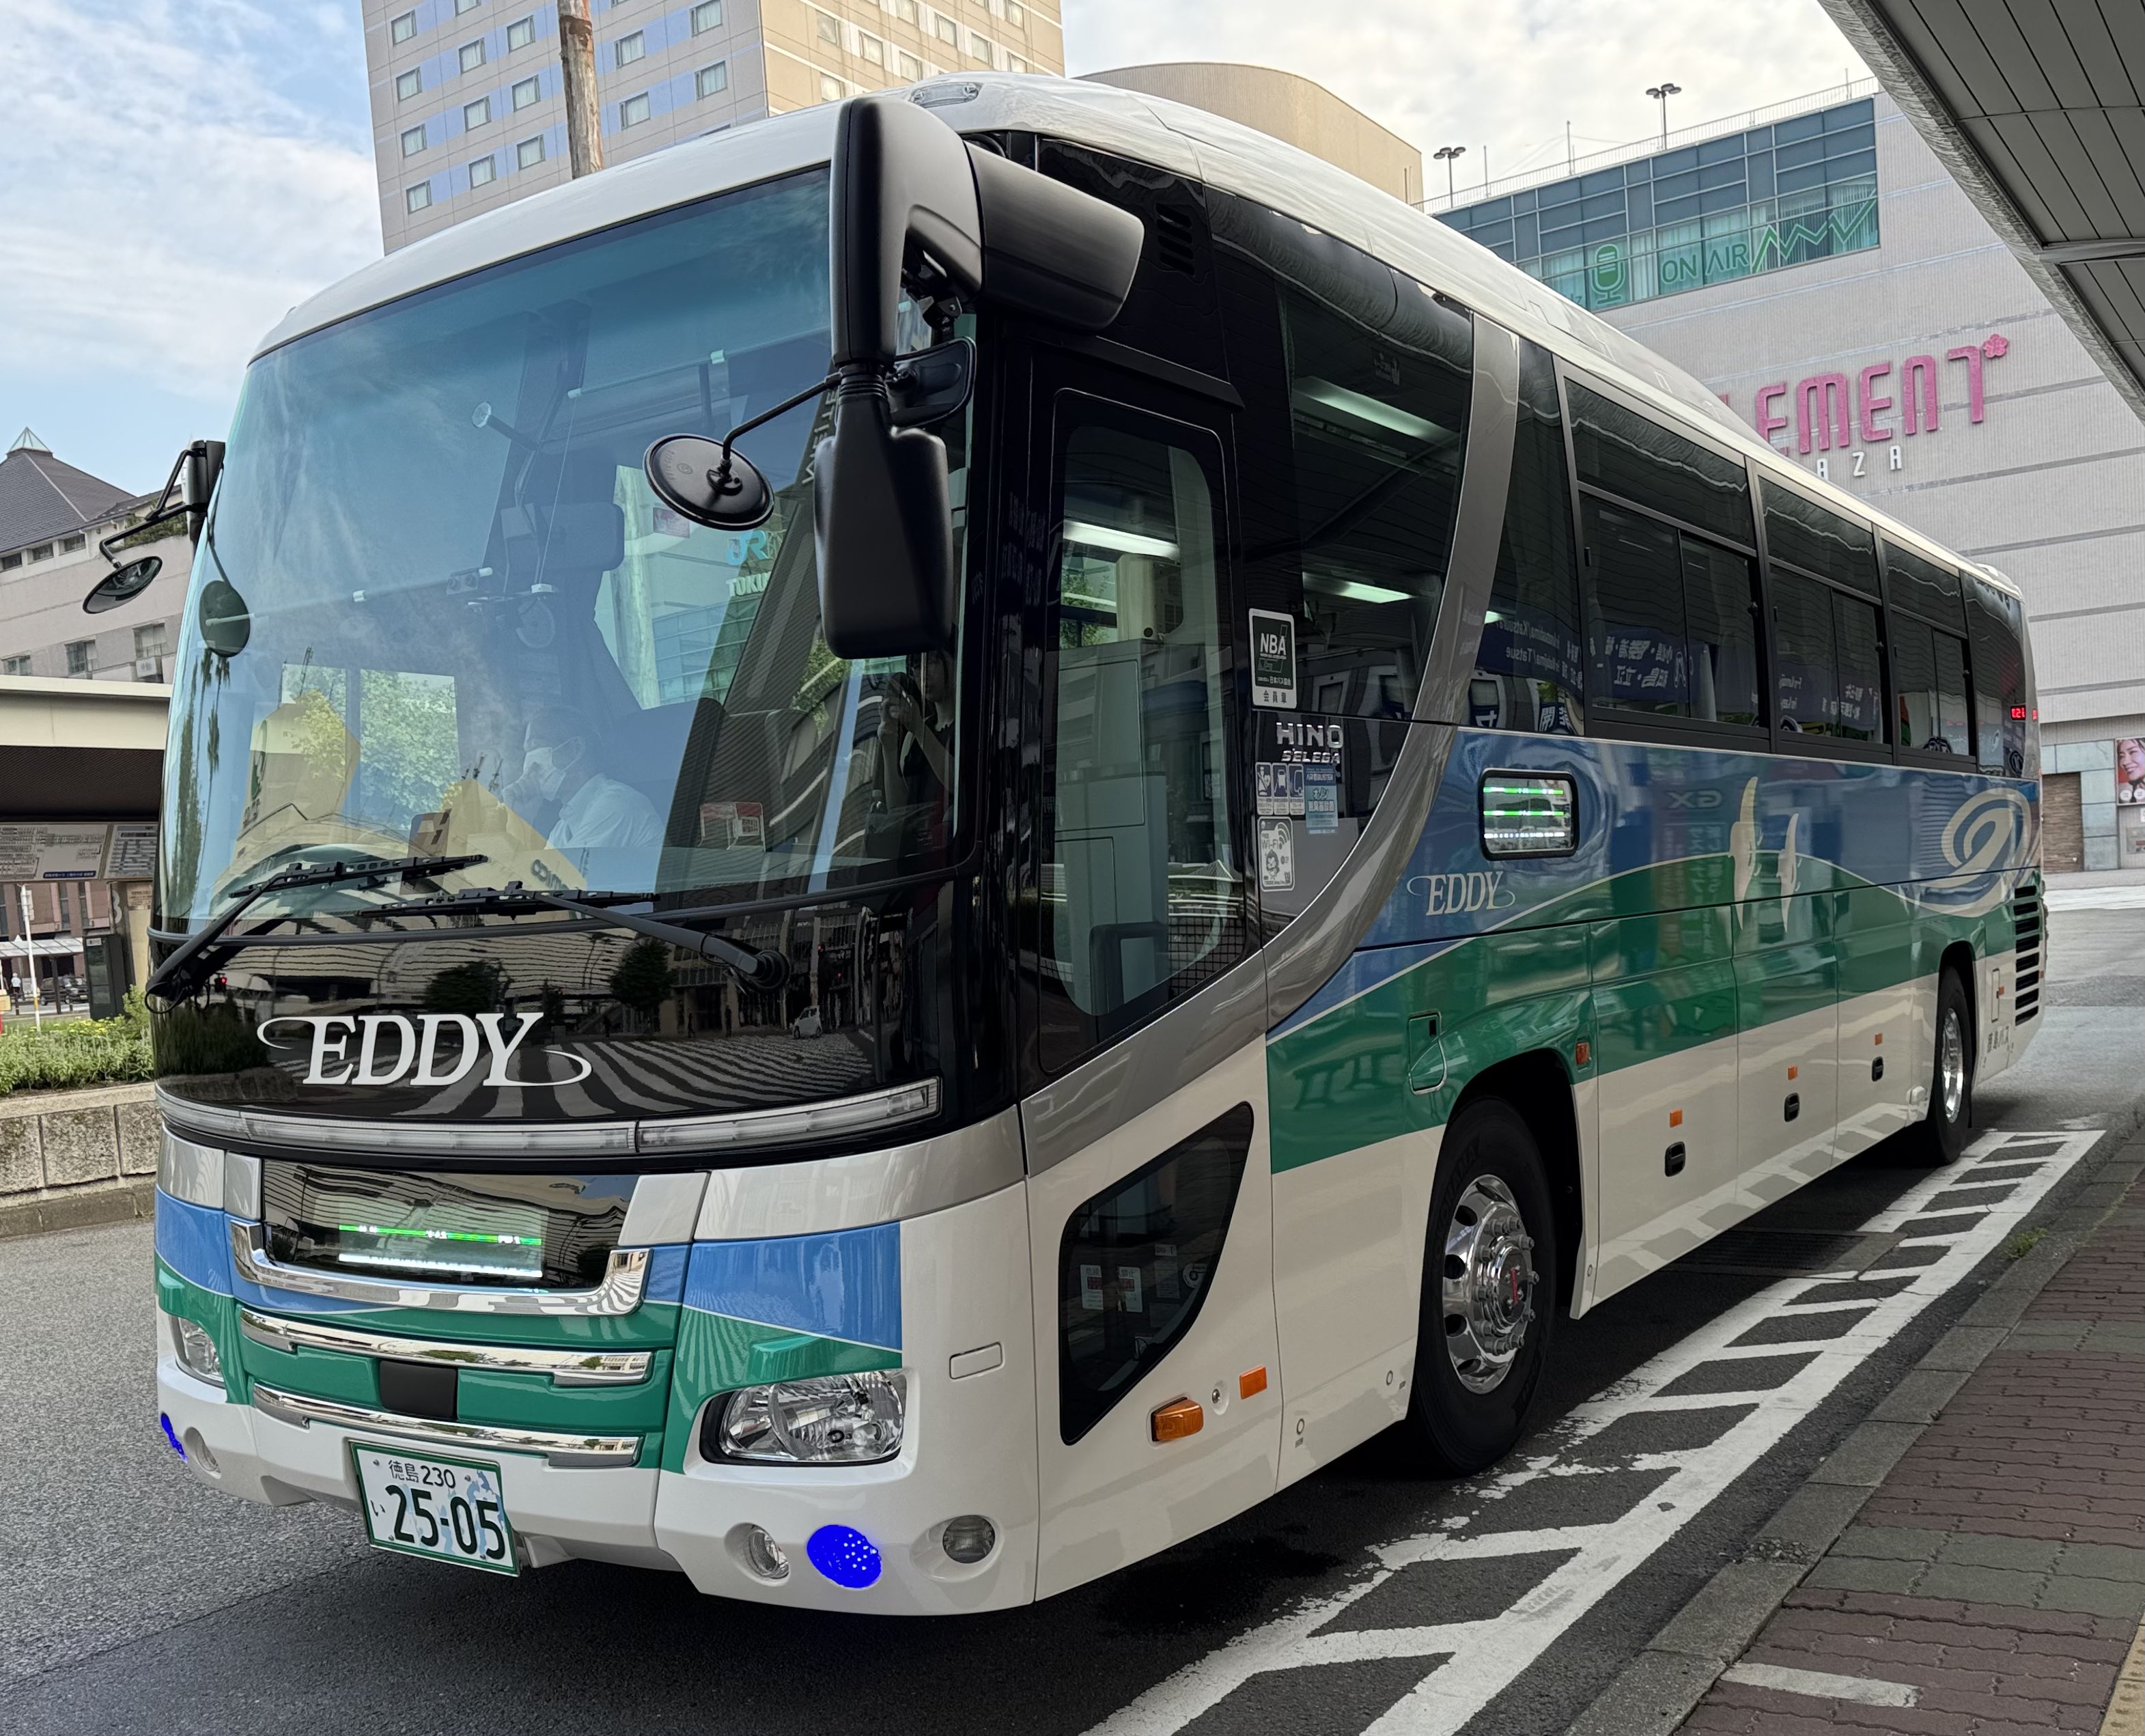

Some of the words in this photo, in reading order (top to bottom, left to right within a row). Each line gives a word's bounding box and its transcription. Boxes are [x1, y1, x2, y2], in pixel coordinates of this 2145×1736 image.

[1661, 254, 1697, 284] ON
[1706, 242, 1749, 275] AIR
[1718, 346, 1984, 456] EMENT
[726, 530, 769, 565] JR
[1260, 632, 1287, 656] NBA
[1276, 722, 1343, 748] HINO
[1281, 751, 1340, 764] SELEGA
[1407, 871, 1515, 916] EDDY
[257, 1012, 592, 1087] EDDY
[388, 1459, 456, 1489] 徳島230
[370, 1500, 386, 1517] い
[385, 1485, 505, 1560] 25-05
